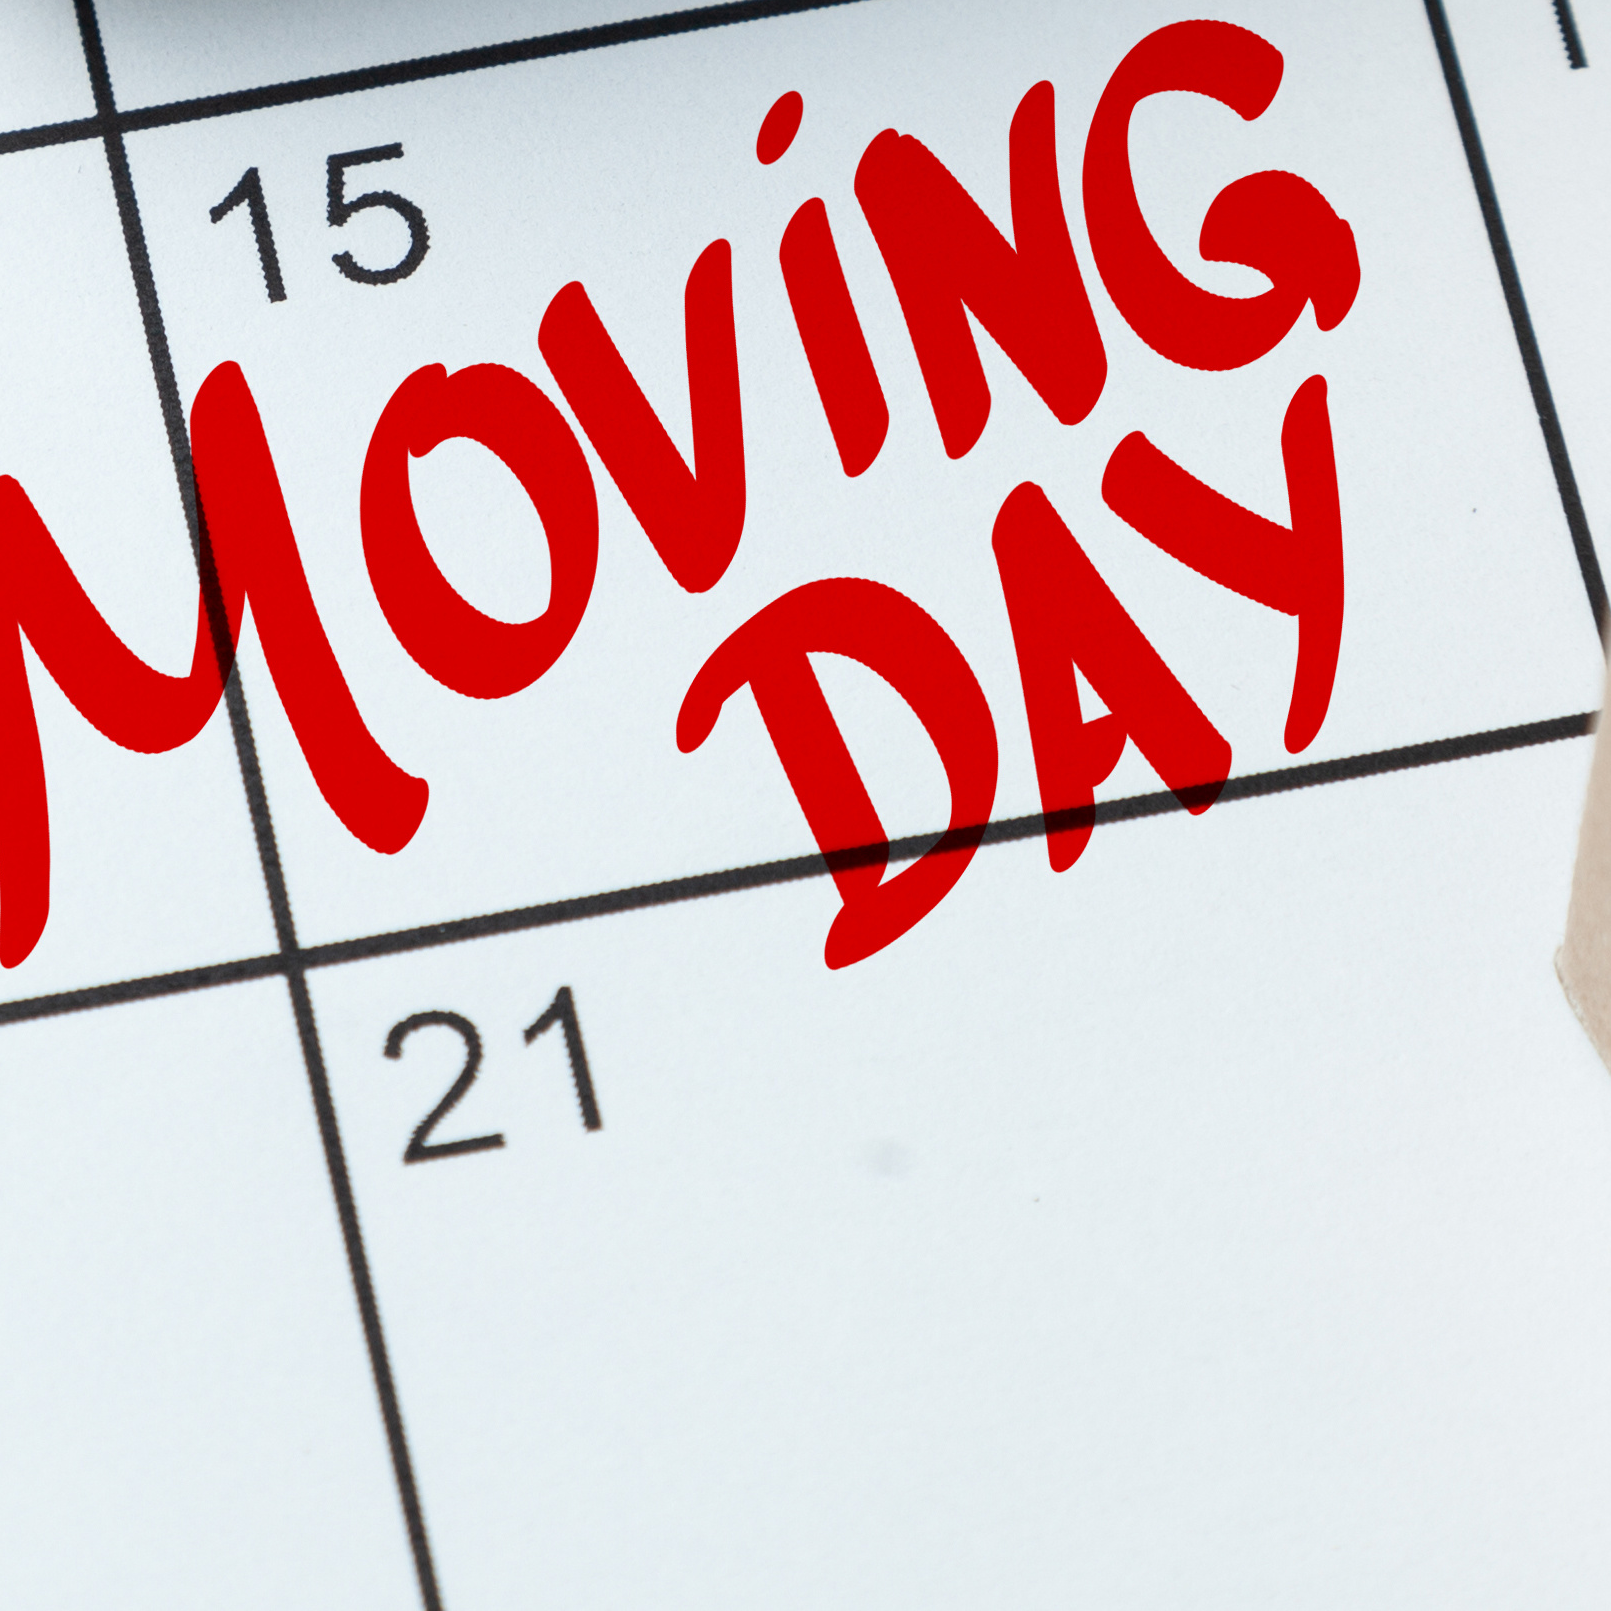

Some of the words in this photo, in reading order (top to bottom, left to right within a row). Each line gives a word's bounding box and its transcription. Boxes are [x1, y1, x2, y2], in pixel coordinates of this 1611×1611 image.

[207, 140, 432, 305] 15
[675, 373, 1346, 971] DAY
[382, 984, 605, 1167] 21
